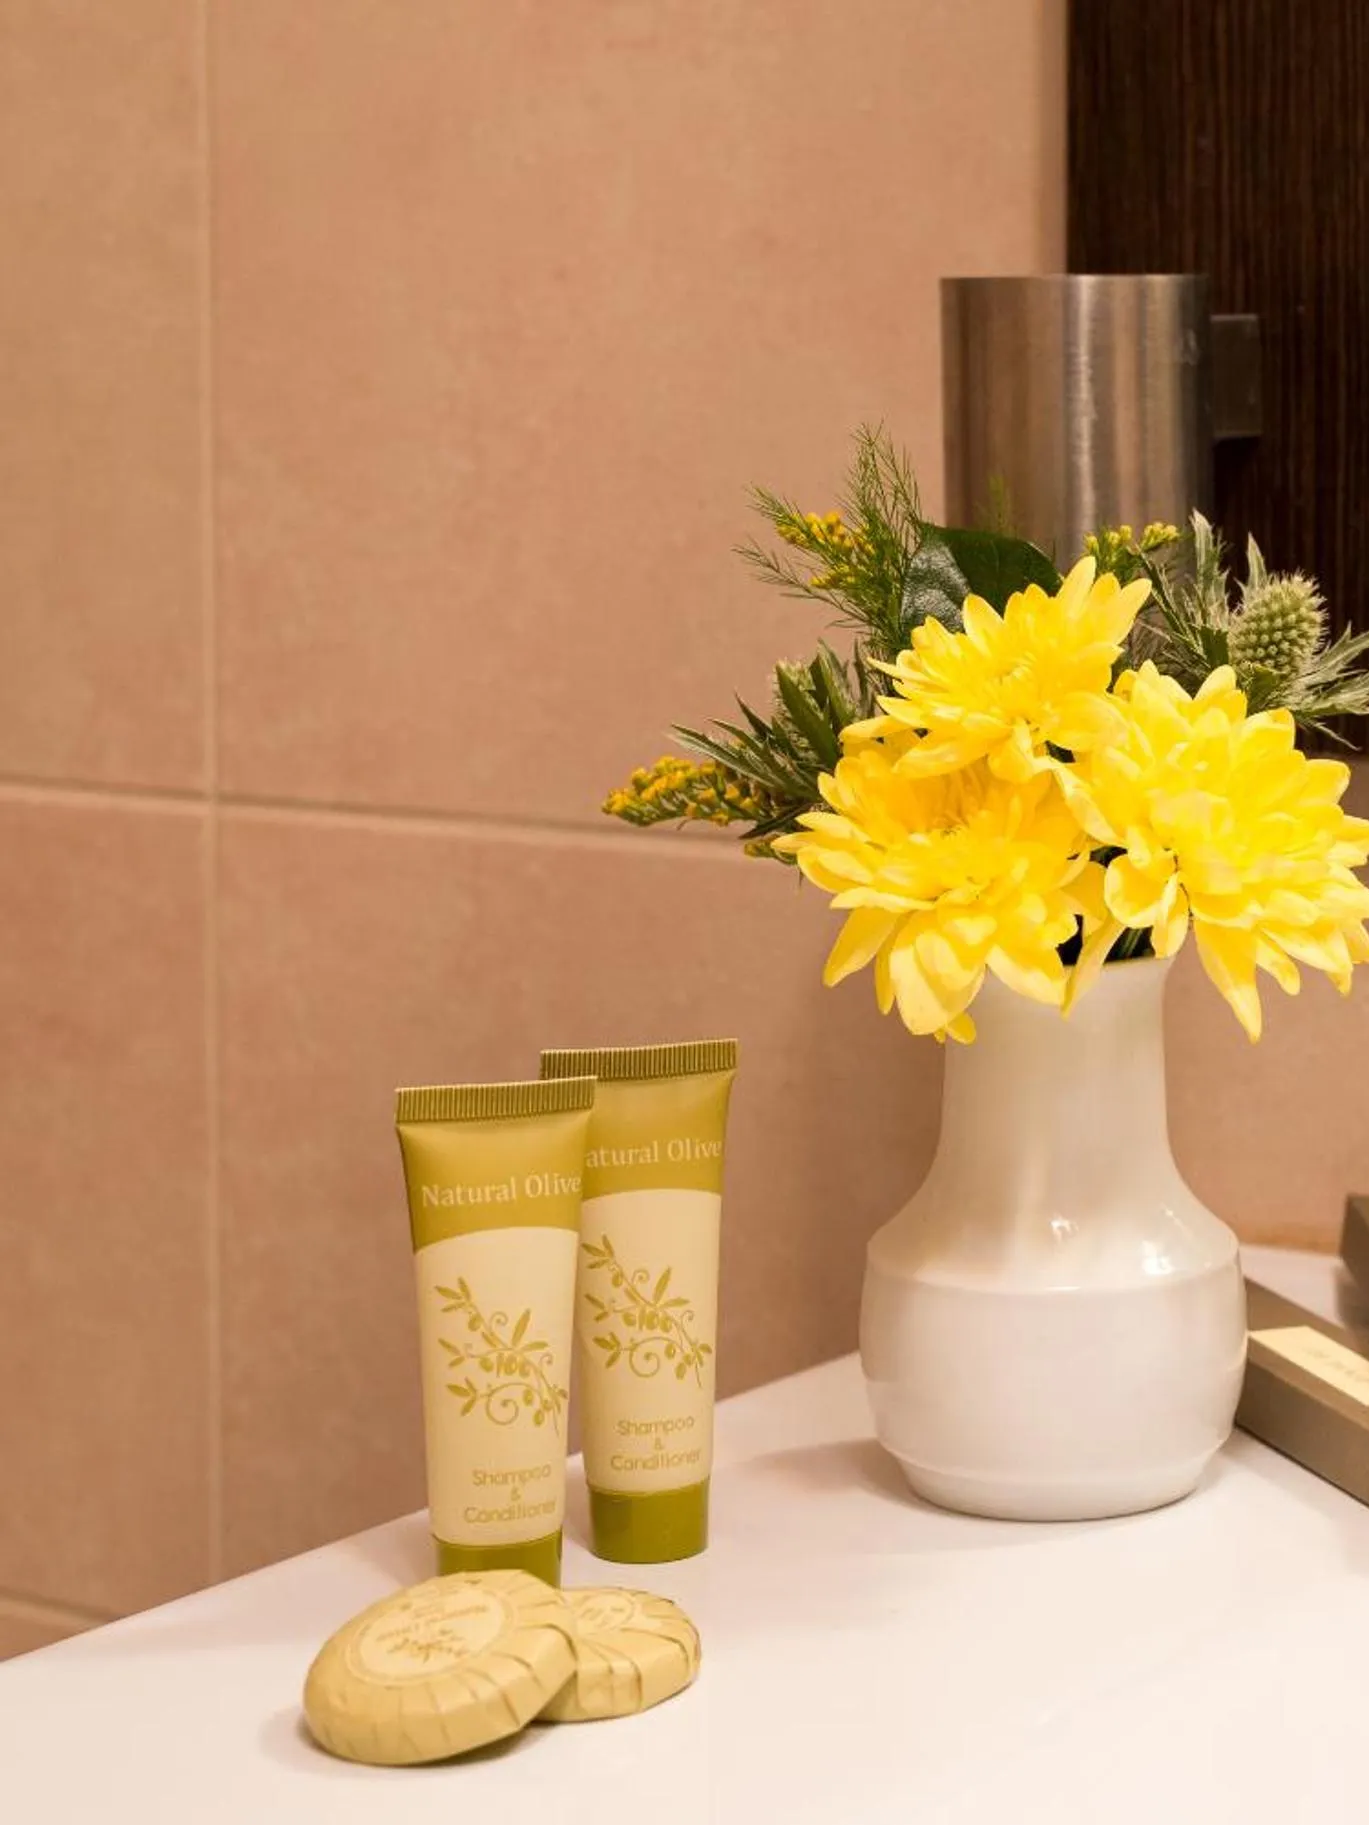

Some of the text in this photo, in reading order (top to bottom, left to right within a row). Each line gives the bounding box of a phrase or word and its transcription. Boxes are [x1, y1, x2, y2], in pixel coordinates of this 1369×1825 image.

[585, 1137, 722, 1169] atural Olive
[421, 1171, 582, 1208] Natural Olive
[616, 1415, 695, 1436] Shampoo
[610, 1448, 701, 1471] Conditioner
[472, 1463, 552, 1487] Shampoo
[464, 1498, 557, 1524] Conditioner
